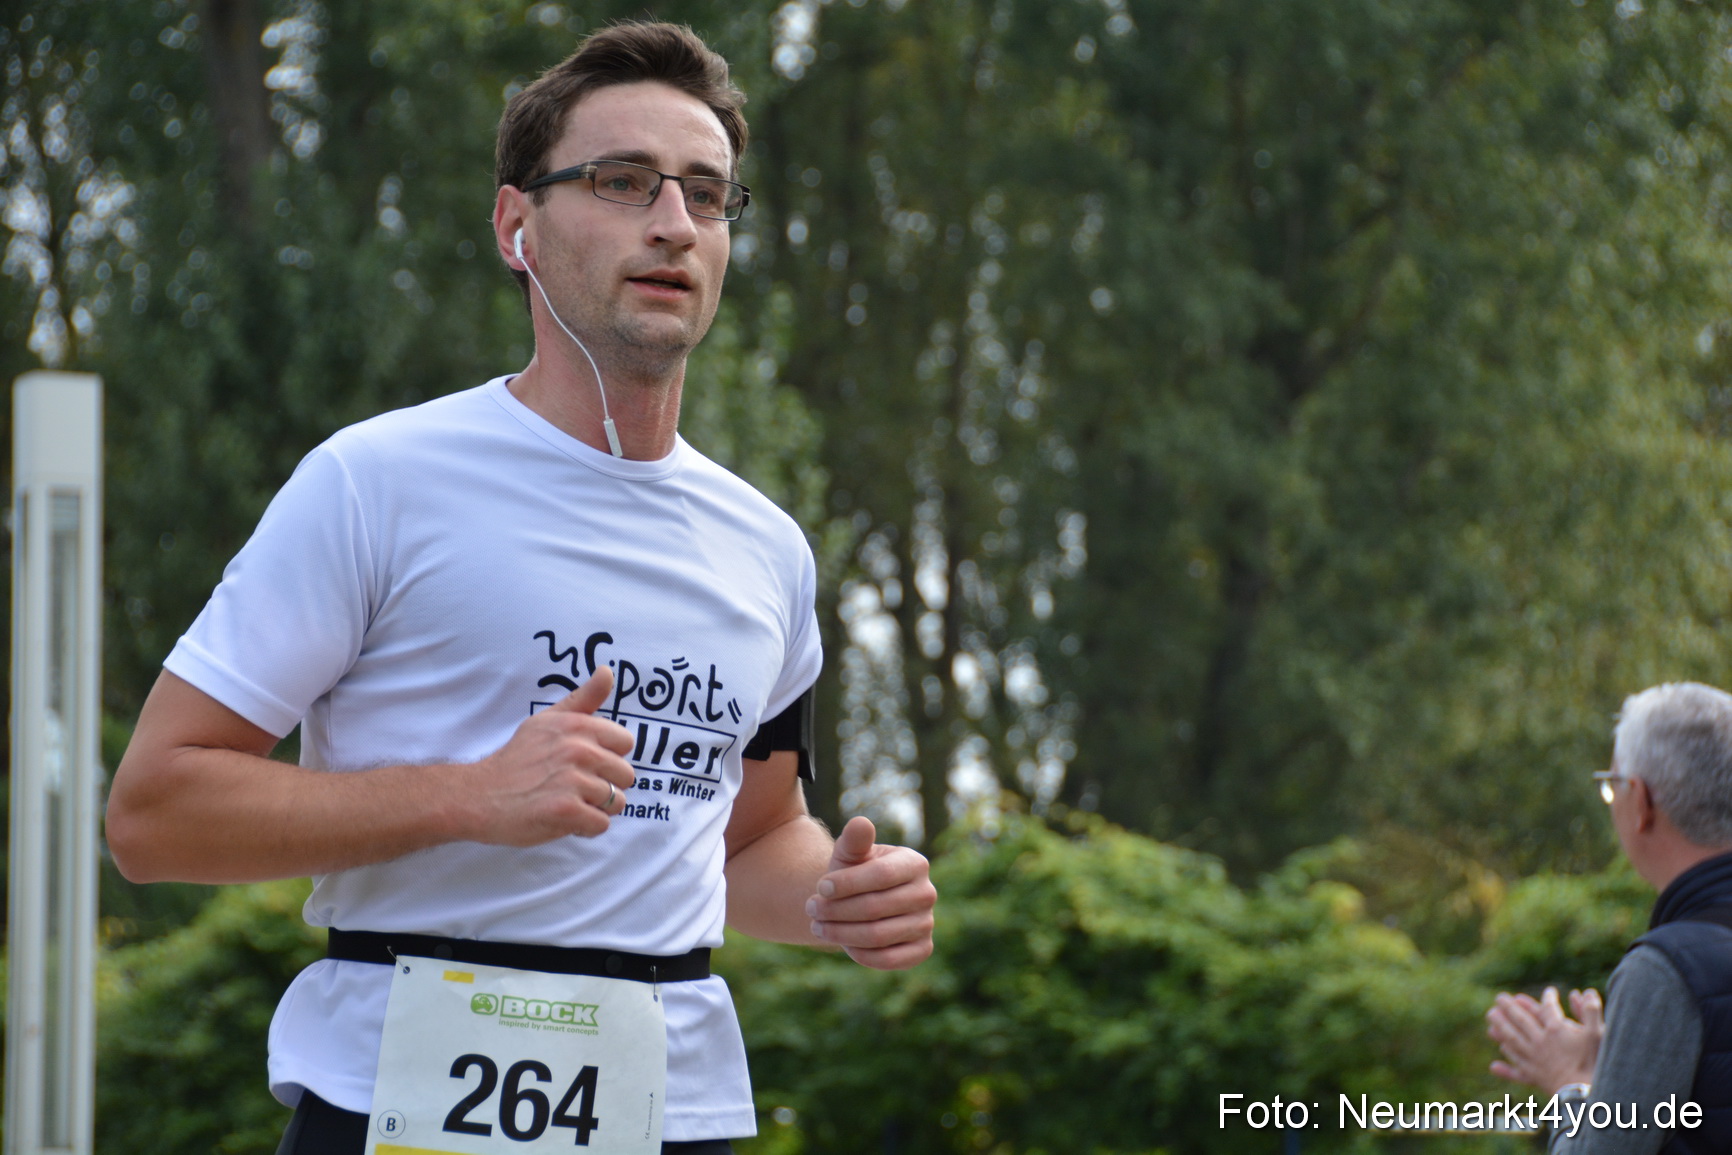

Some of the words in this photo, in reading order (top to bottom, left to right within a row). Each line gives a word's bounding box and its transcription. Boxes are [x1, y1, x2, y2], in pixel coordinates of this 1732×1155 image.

[616, 719, 722, 775] ller
[668, 777, 716, 801] Winter
[619, 802, 670, 821] markt
[500, 995, 599, 1027] BOCK
[499, 1019, 529, 1029] inspired
[531, 1022, 541, 1031] by
[543, 1024, 565, 1033] smart
[567, 1027, 599, 1036] concepts
[442, 1053, 599, 1147] 264
[385, 1117, 397, 1132] B
